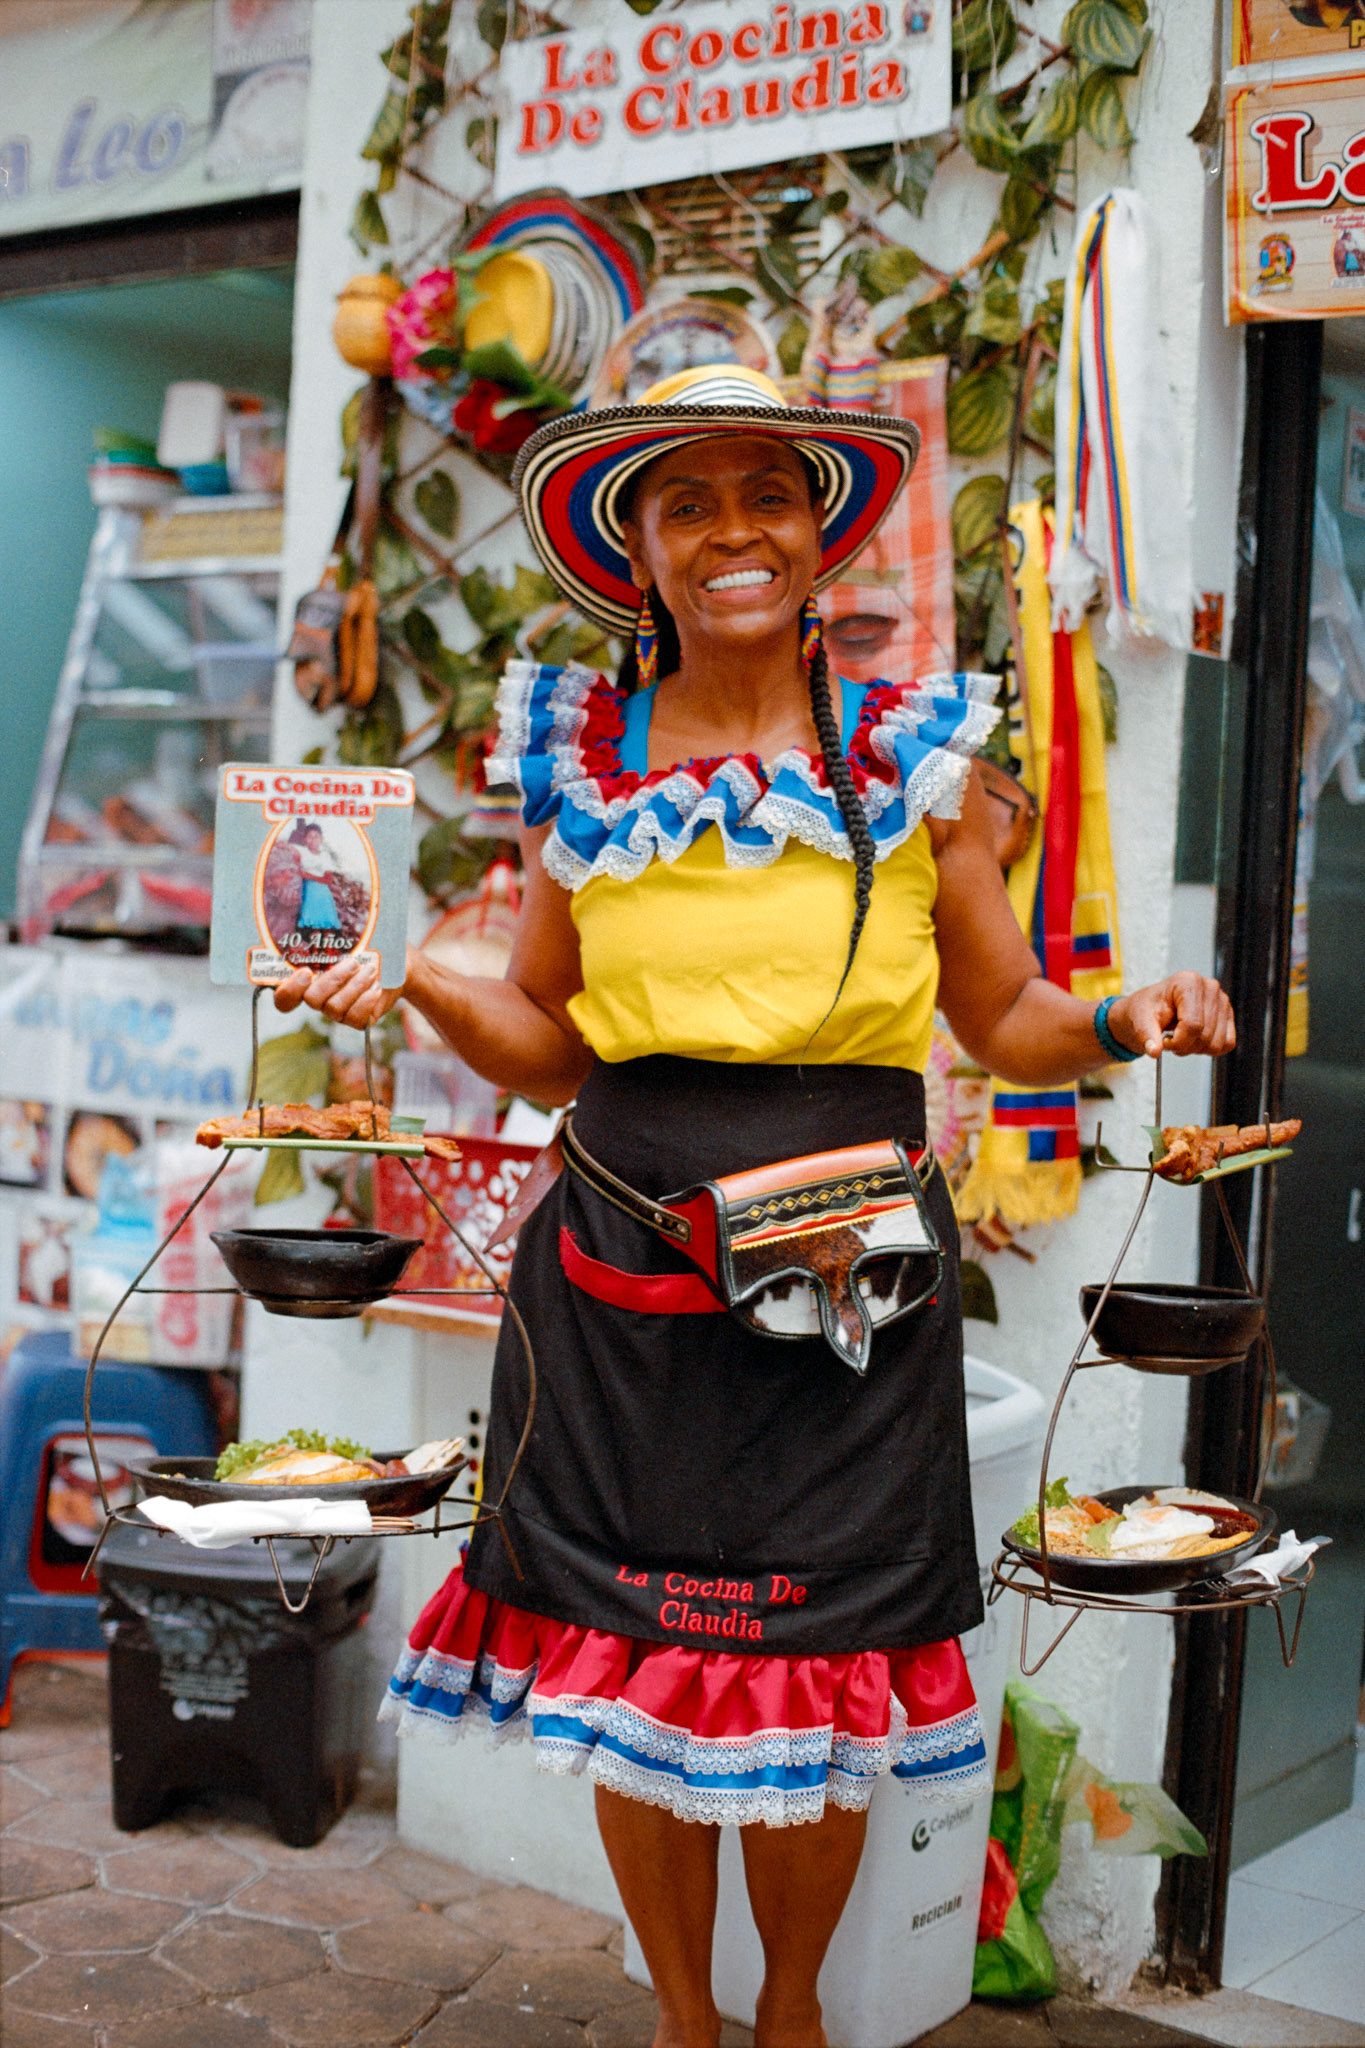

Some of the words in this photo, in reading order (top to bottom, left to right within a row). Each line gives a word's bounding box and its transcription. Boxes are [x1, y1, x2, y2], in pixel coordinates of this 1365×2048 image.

[542, 42, 617, 95] La
[638, 2, 887, 76] Cocina
[517, 99, 601, 155] De
[623, 51, 906, 138] Claudia
[234, 775, 265, 792] La
[273, 776, 364, 795] Cocina
[372, 780, 405, 797] De
[268, 797, 371, 817] Claudia
[278, 932, 302, 948] 40
[304, 932, 355, 950] Años
[615, 1565, 649, 1587] La
[664, 1571, 754, 1602] Cocina
[768, 1574, 808, 1605] De
[659, 1600, 763, 1640] Claudia
